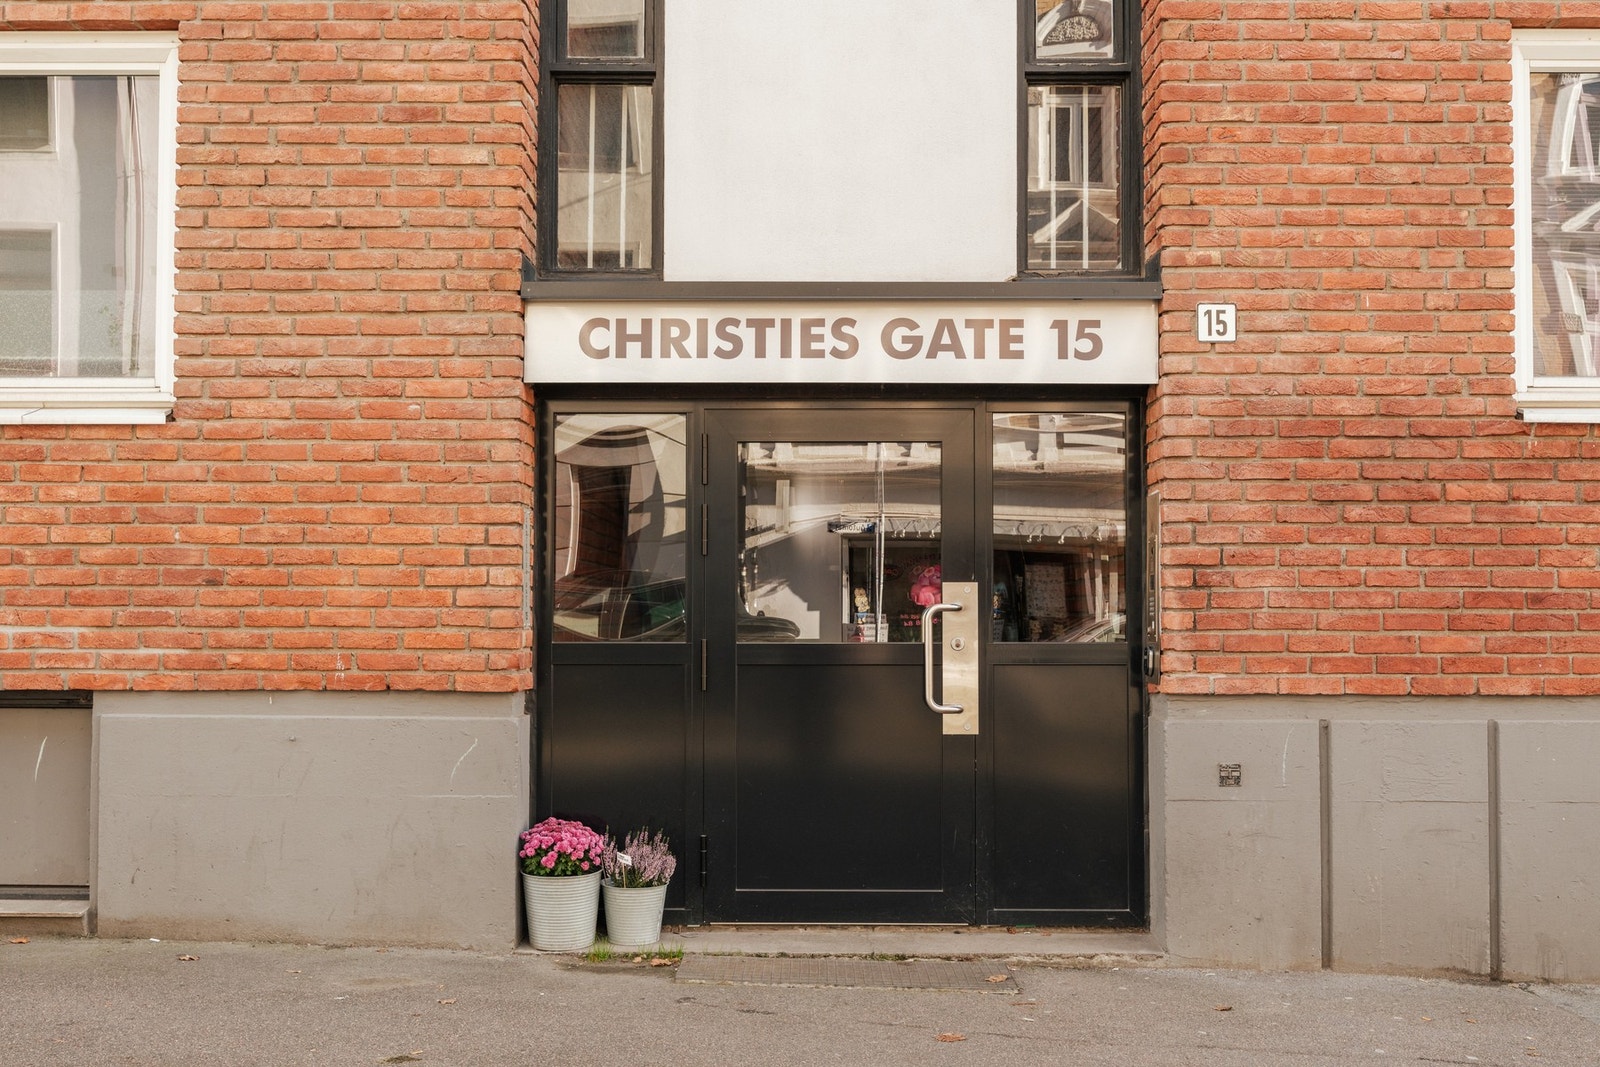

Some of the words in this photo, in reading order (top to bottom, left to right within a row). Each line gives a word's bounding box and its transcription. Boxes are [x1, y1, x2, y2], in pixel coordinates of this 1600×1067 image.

[579, 317, 859, 360] CHRISTIES
[881, 317, 1025, 360] GATE
[1050, 319, 1103, 360] 15
[1203, 309, 1228, 337] 15
